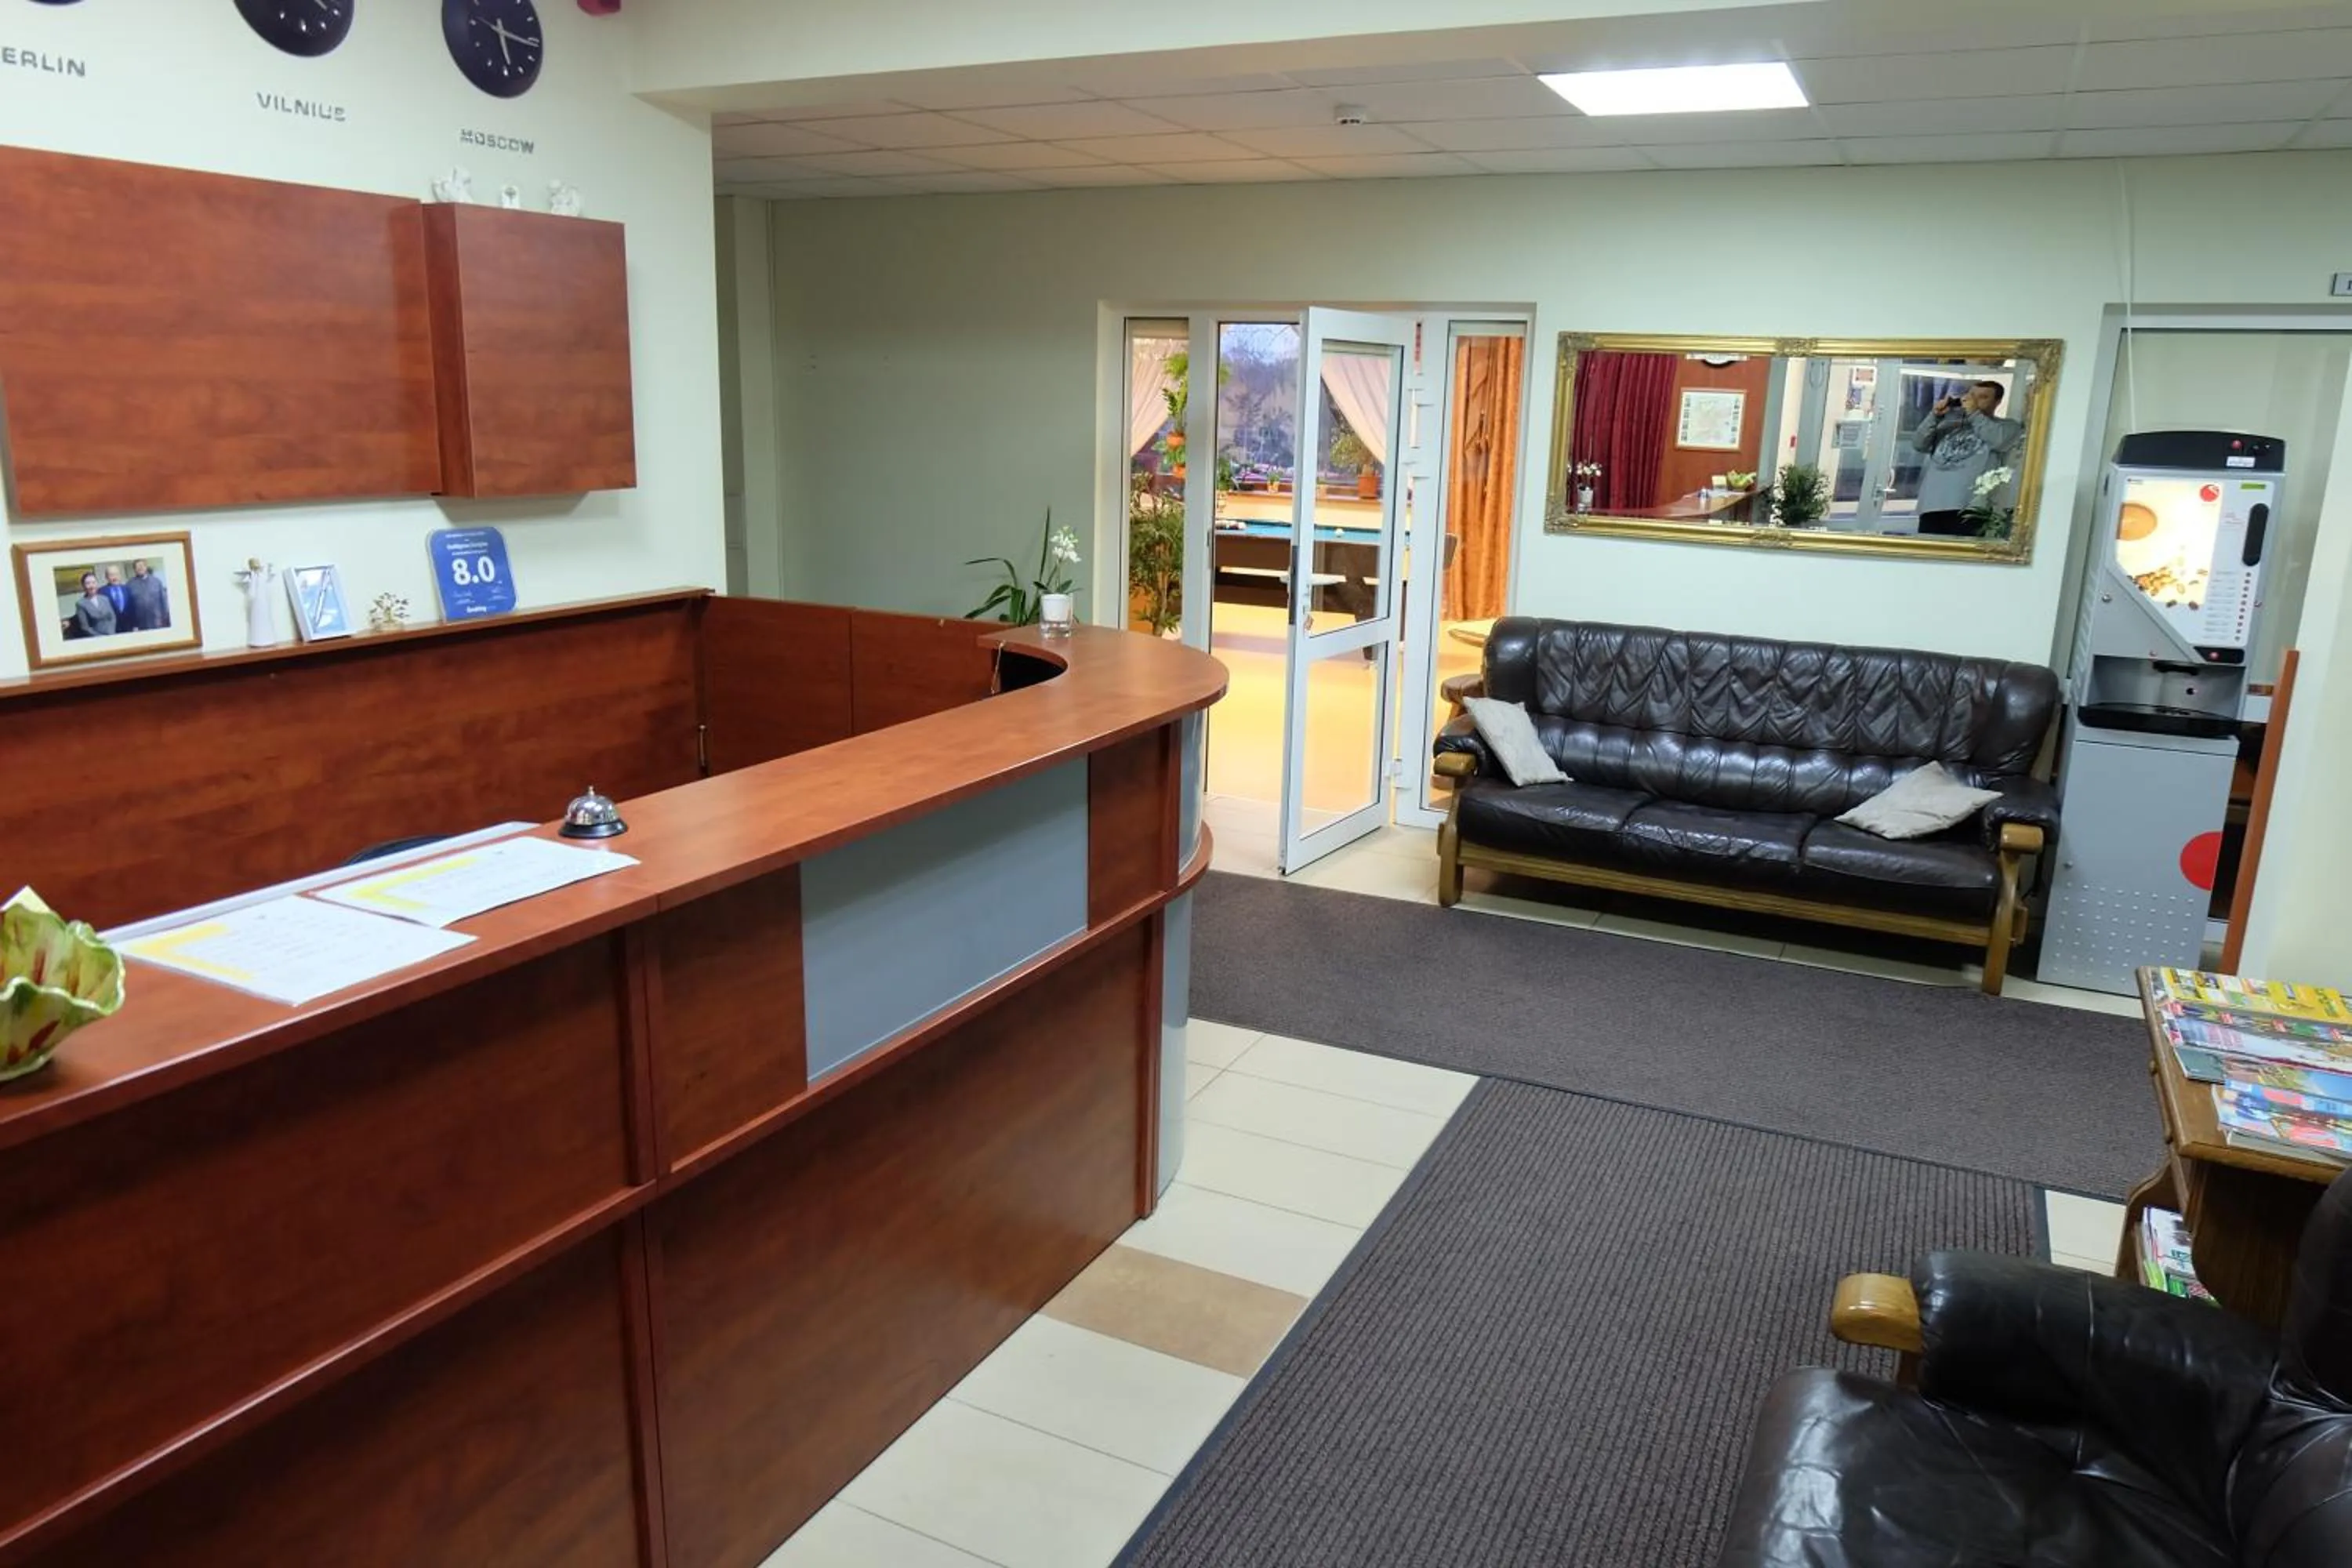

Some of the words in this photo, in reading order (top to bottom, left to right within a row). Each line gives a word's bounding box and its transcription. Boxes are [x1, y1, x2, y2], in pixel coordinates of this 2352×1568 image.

[256, 92, 346, 122] VILNIUS
[460, 129, 535, 154] MOSCOW
[452, 555, 495, 586] 8.0
